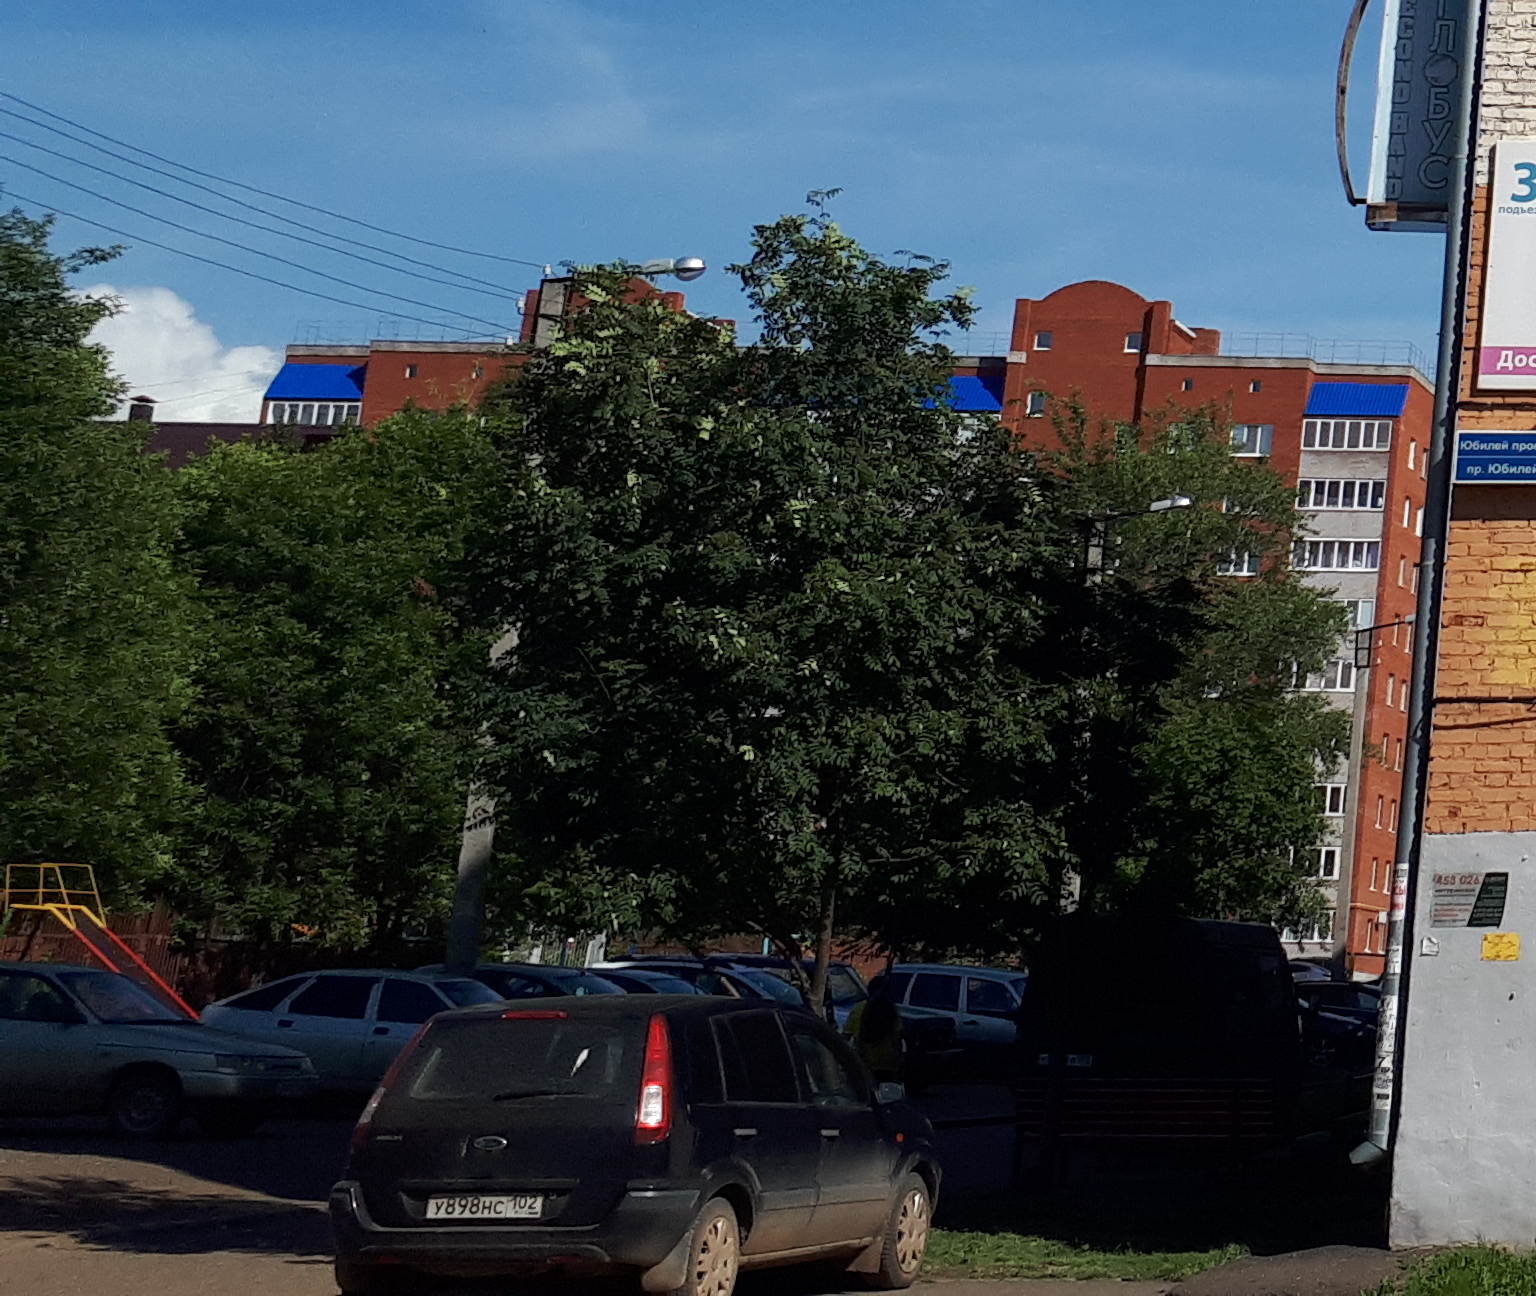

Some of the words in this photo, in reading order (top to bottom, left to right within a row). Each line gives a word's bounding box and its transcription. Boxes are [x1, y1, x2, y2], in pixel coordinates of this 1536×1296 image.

[1459, 440, 1508, 451] Юбилей
[1466, 466, 1485, 476] пр.
[434, 1196, 505, 1216] У898НС
[511, 1195, 538, 1210] 102
